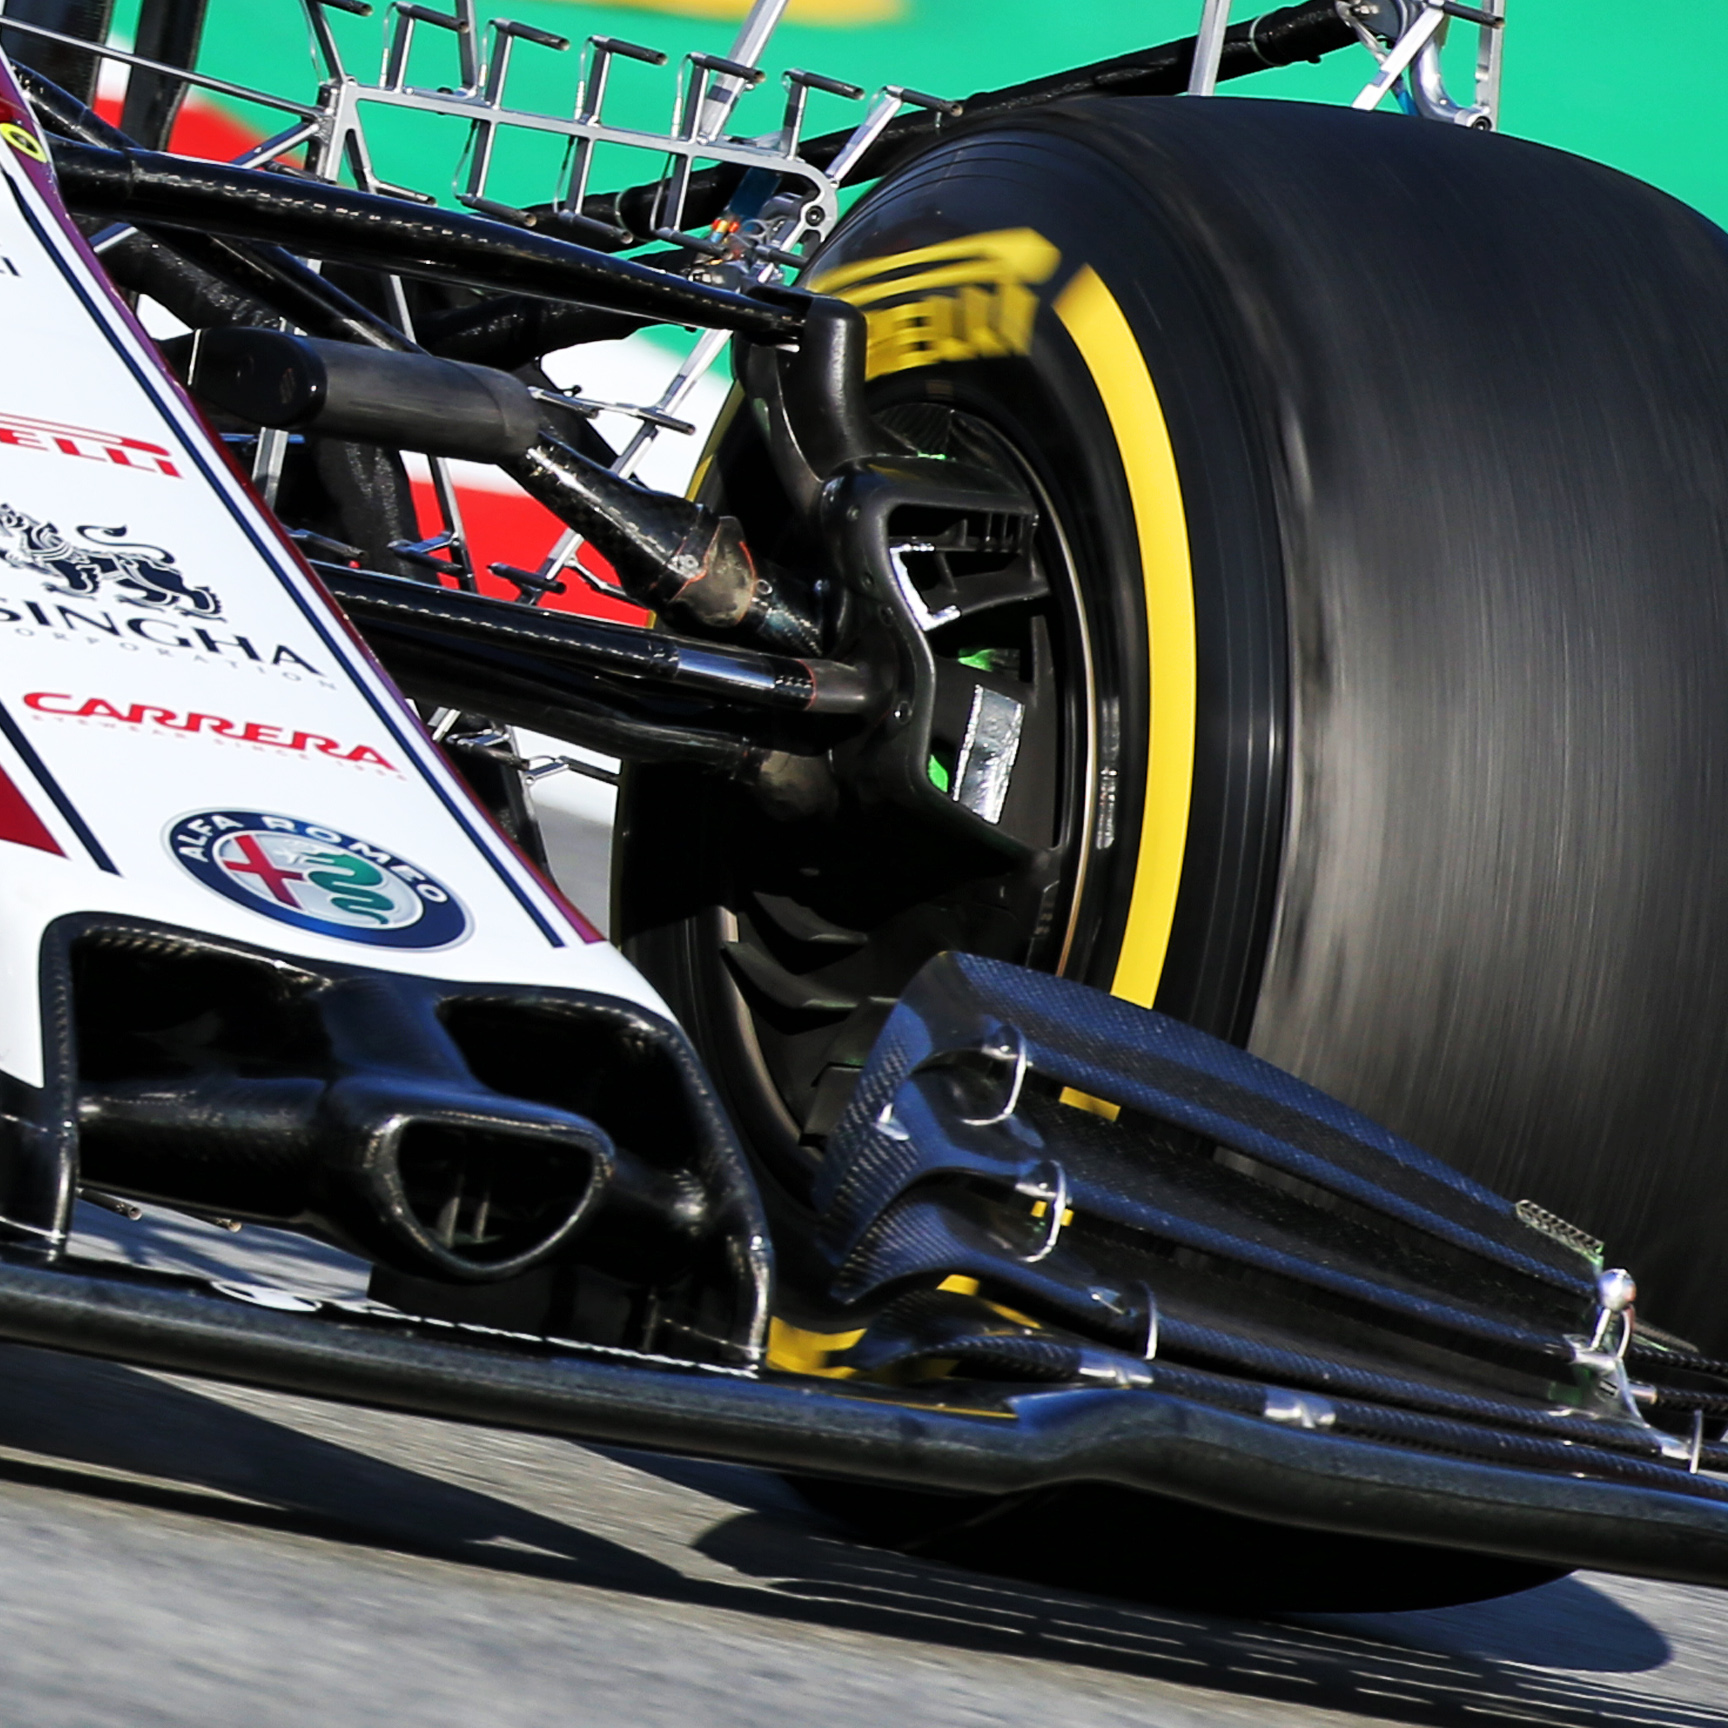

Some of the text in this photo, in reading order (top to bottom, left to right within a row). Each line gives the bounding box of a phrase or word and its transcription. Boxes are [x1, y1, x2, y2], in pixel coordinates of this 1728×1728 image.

[22, 692, 399, 772] CARRERA
[178, 814, 448, 904] ALFA ROMEO
